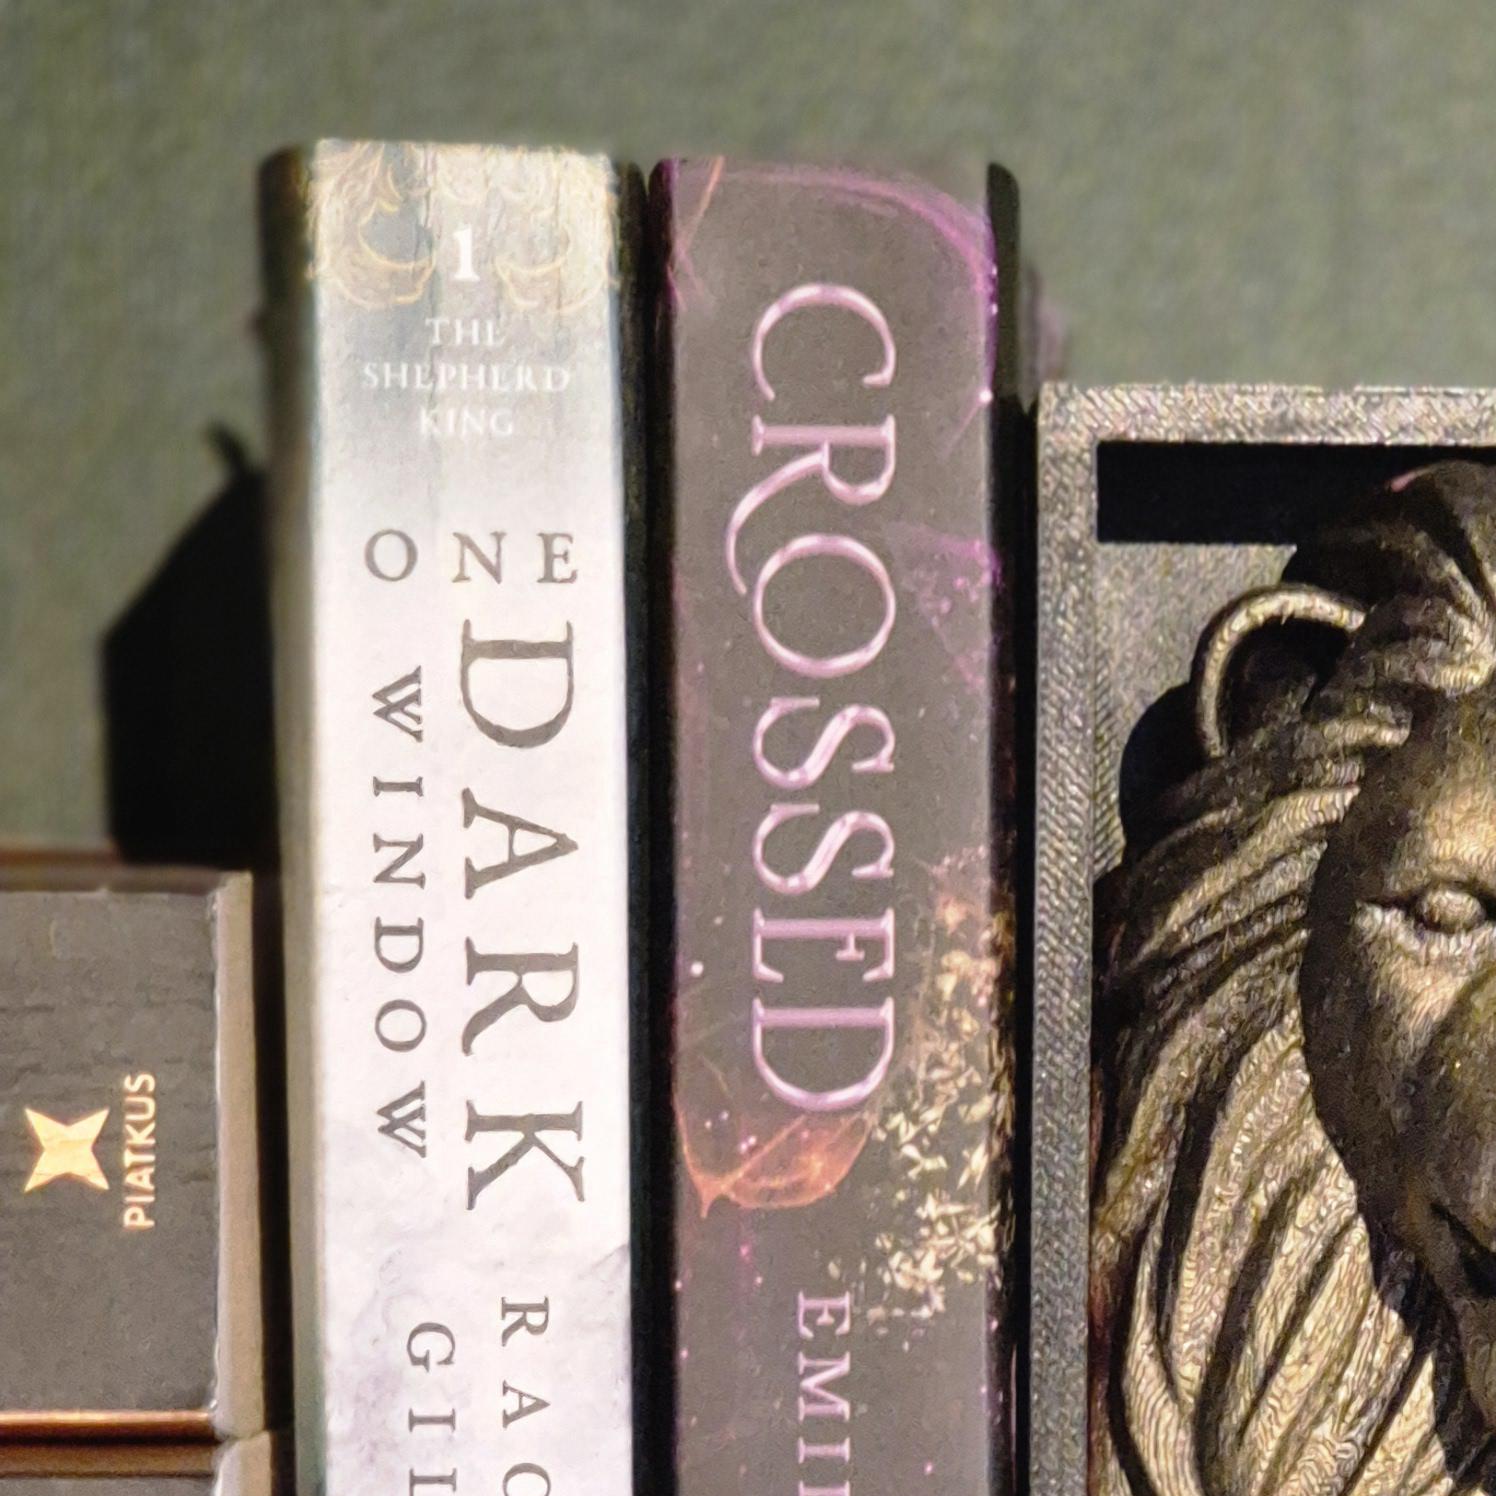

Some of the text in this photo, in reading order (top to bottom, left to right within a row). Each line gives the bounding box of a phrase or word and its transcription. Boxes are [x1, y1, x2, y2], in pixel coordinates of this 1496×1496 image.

[453, 226, 481, 281] 1
[425, 318, 505, 346] THE
[361, 363, 572, 392] SHEPHERD
[419, 407, 514, 437] KING
[364, 529, 578, 584] ONE
[725, 282, 895, 1111] CROSSED
[371, 665, 427, 1159] WINDOW
[460, 618, 585, 1211] DARK
[123, 1072, 156, 1229] PIATKUS
